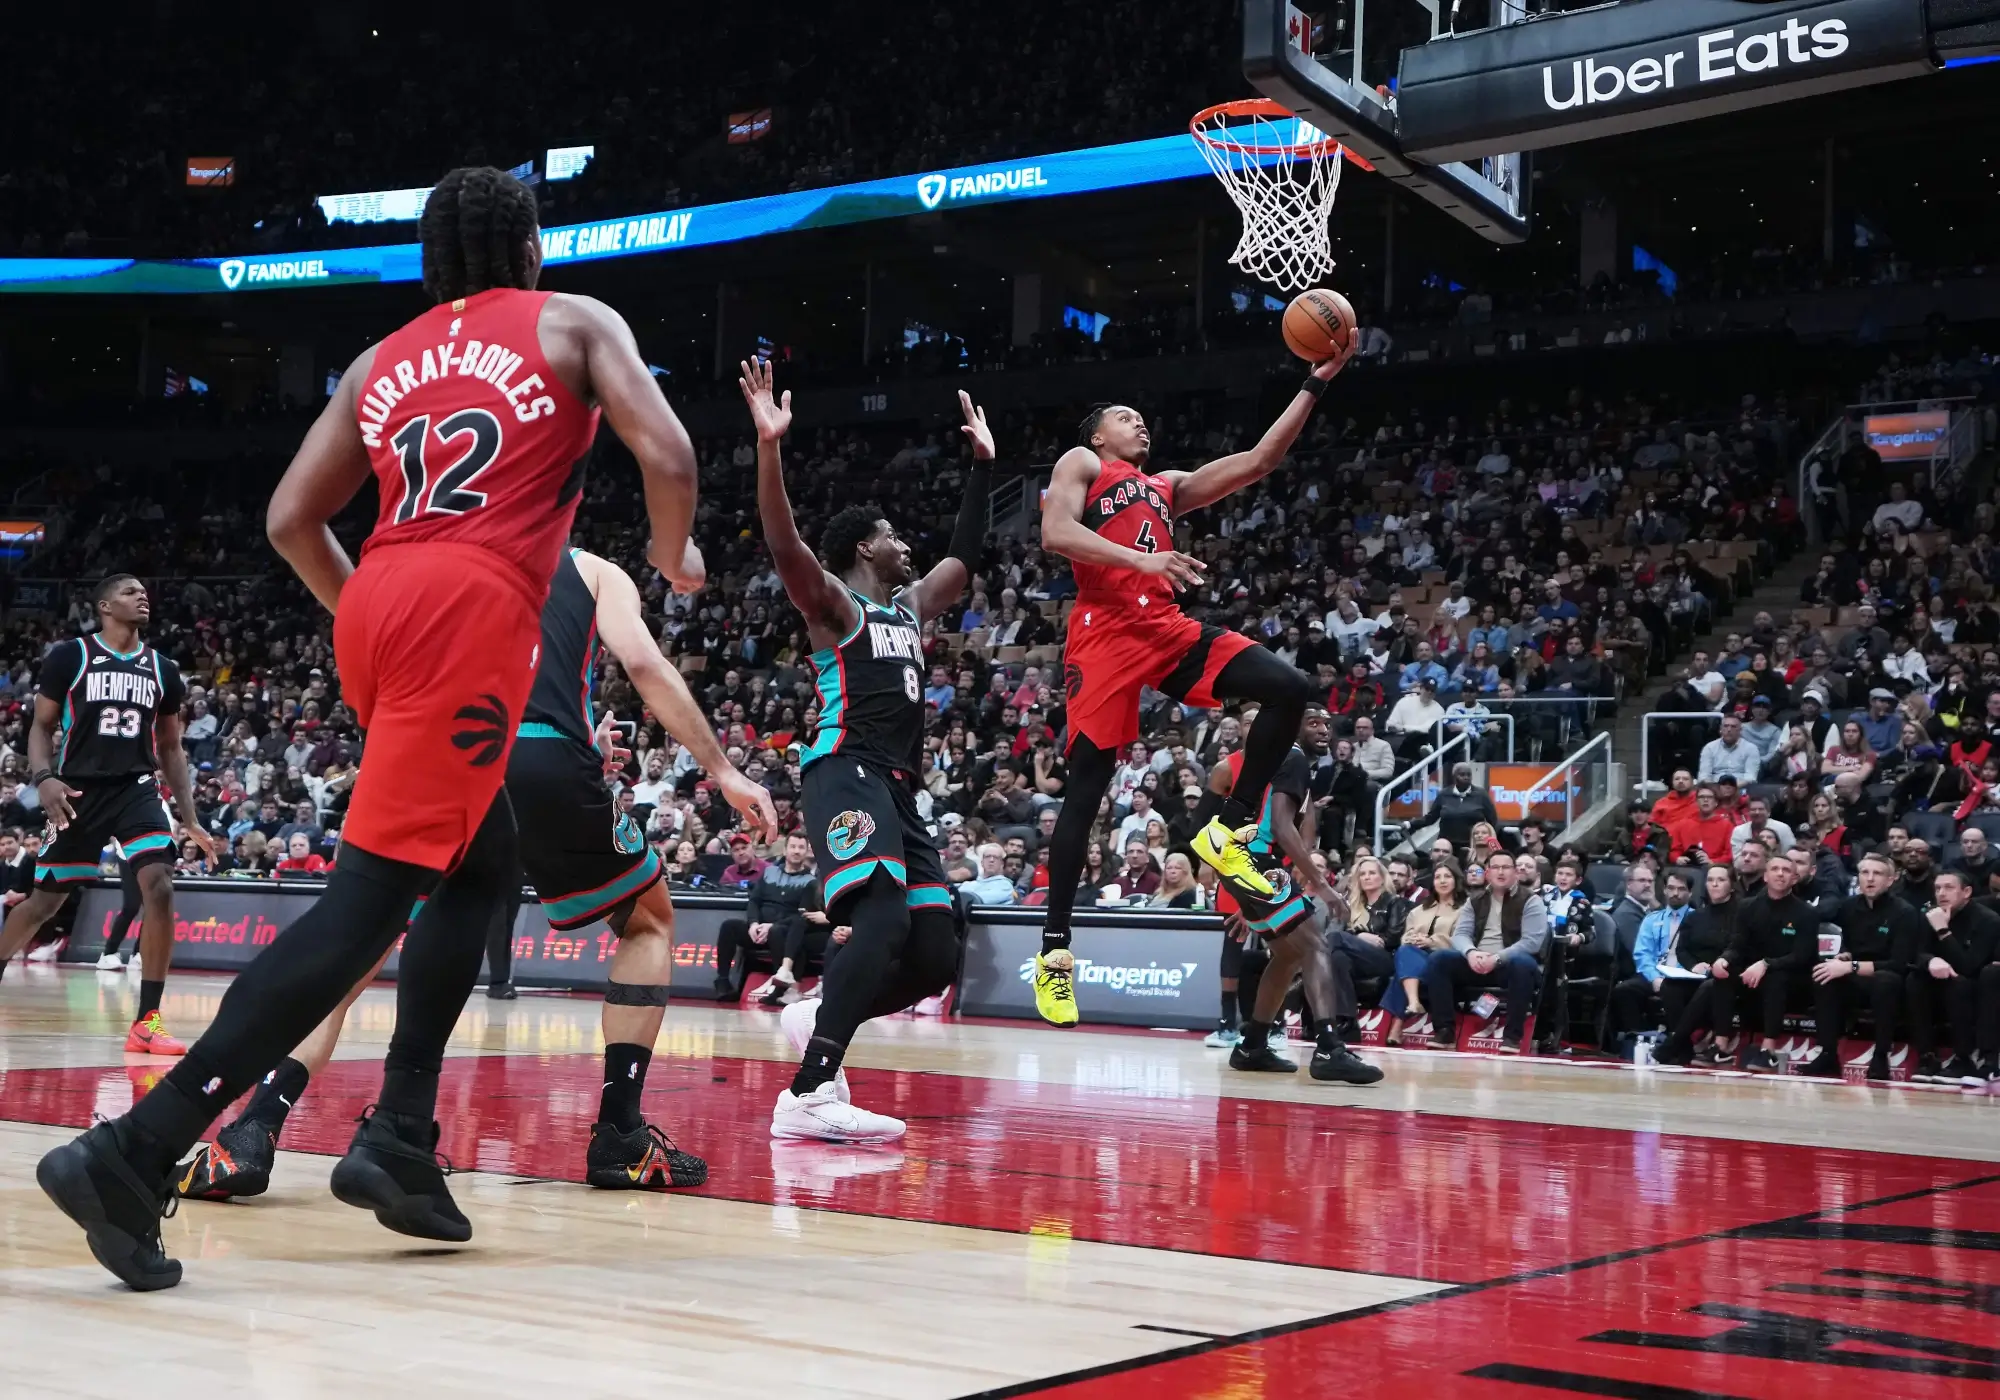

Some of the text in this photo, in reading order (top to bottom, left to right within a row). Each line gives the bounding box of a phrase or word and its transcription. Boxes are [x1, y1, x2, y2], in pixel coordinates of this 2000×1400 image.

[1543, 18, 1849, 110] Uber Eats
[949, 167, 1048, 198] FANDUEL
[541, 212, 693, 259] AME GAME PARLAY
[247, 259, 330, 283] FANDUEL
[1306, 293, 1342, 332] Wilson
[359, 339, 557, 449] MURRAY-BOYLES
[389, 407, 503, 526] 12
[1135, 519, 1157, 554] 4
[86, 670, 156, 709] MEMPHIS
[902, 664, 921, 704] 8
[98, 705, 141, 738] 23
[252, 915, 278, 945] in
[542, 928, 587, 961] for
[1075, 959, 1182, 989] Tangerine
